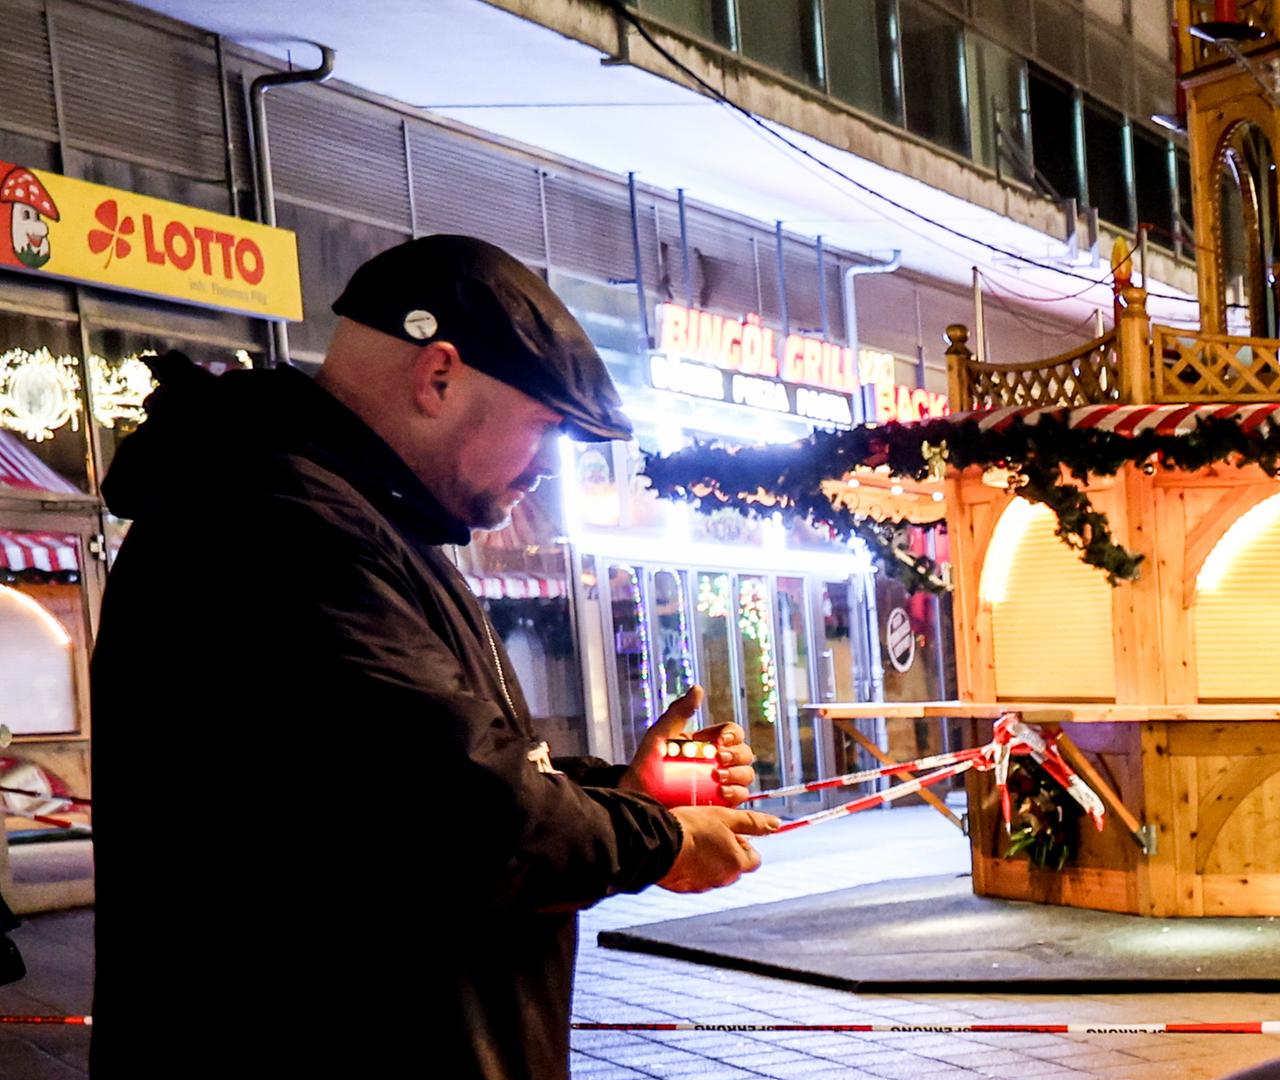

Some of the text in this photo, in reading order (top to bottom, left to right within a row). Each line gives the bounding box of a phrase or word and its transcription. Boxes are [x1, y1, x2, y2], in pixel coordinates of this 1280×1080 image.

[142, 213, 265, 286] LOTTO
[660, 302, 779, 379] BINGÖL
[780, 333, 860, 395] GRILL
